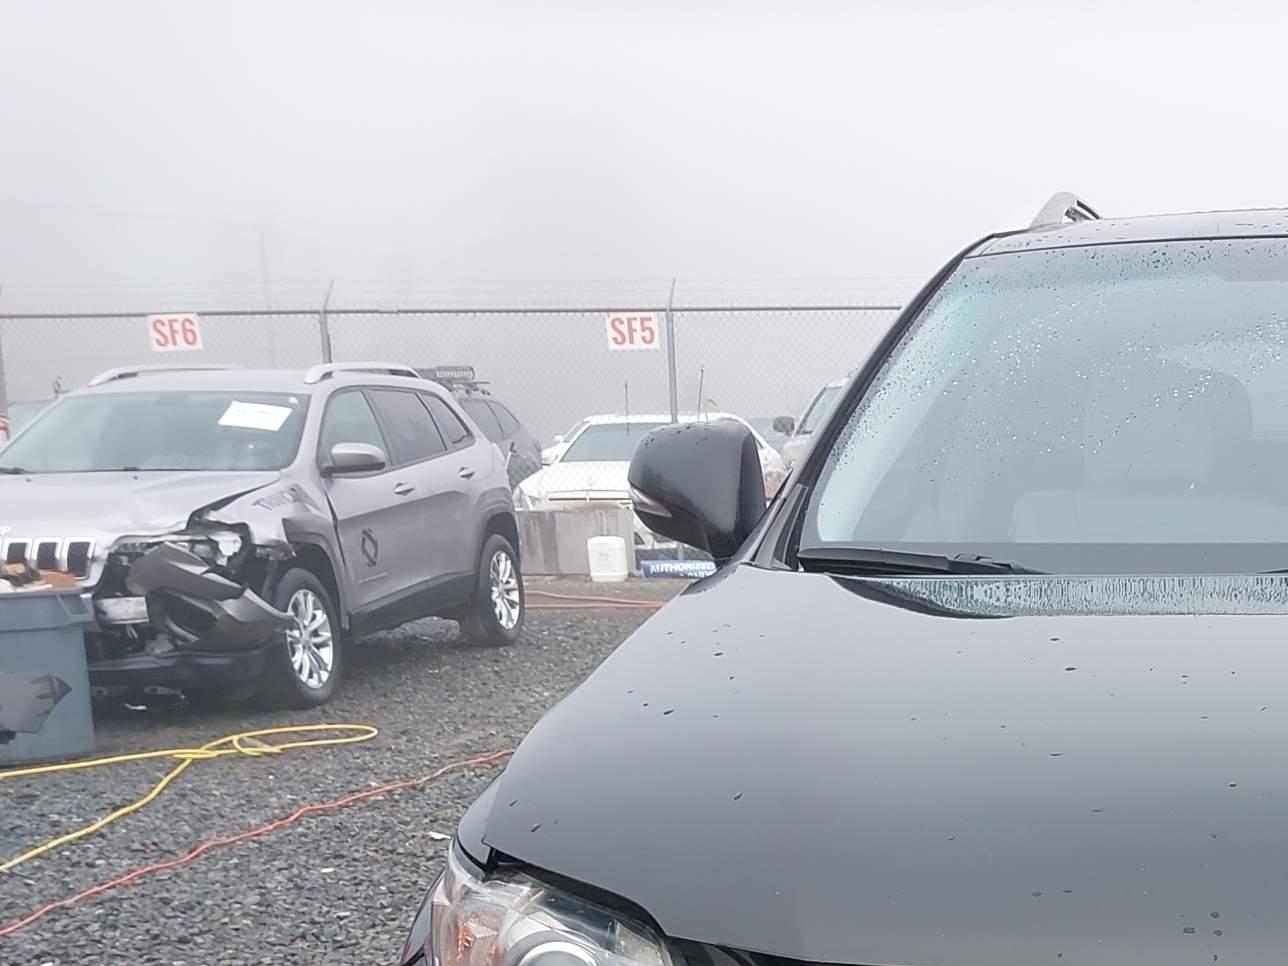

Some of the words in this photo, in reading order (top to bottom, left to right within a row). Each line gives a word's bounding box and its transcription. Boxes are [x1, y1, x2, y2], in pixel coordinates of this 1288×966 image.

[152, 318, 198, 347] SF6
[610, 317, 656, 346] SF5
[650, 562, 715, 575] AUTHORIZED
